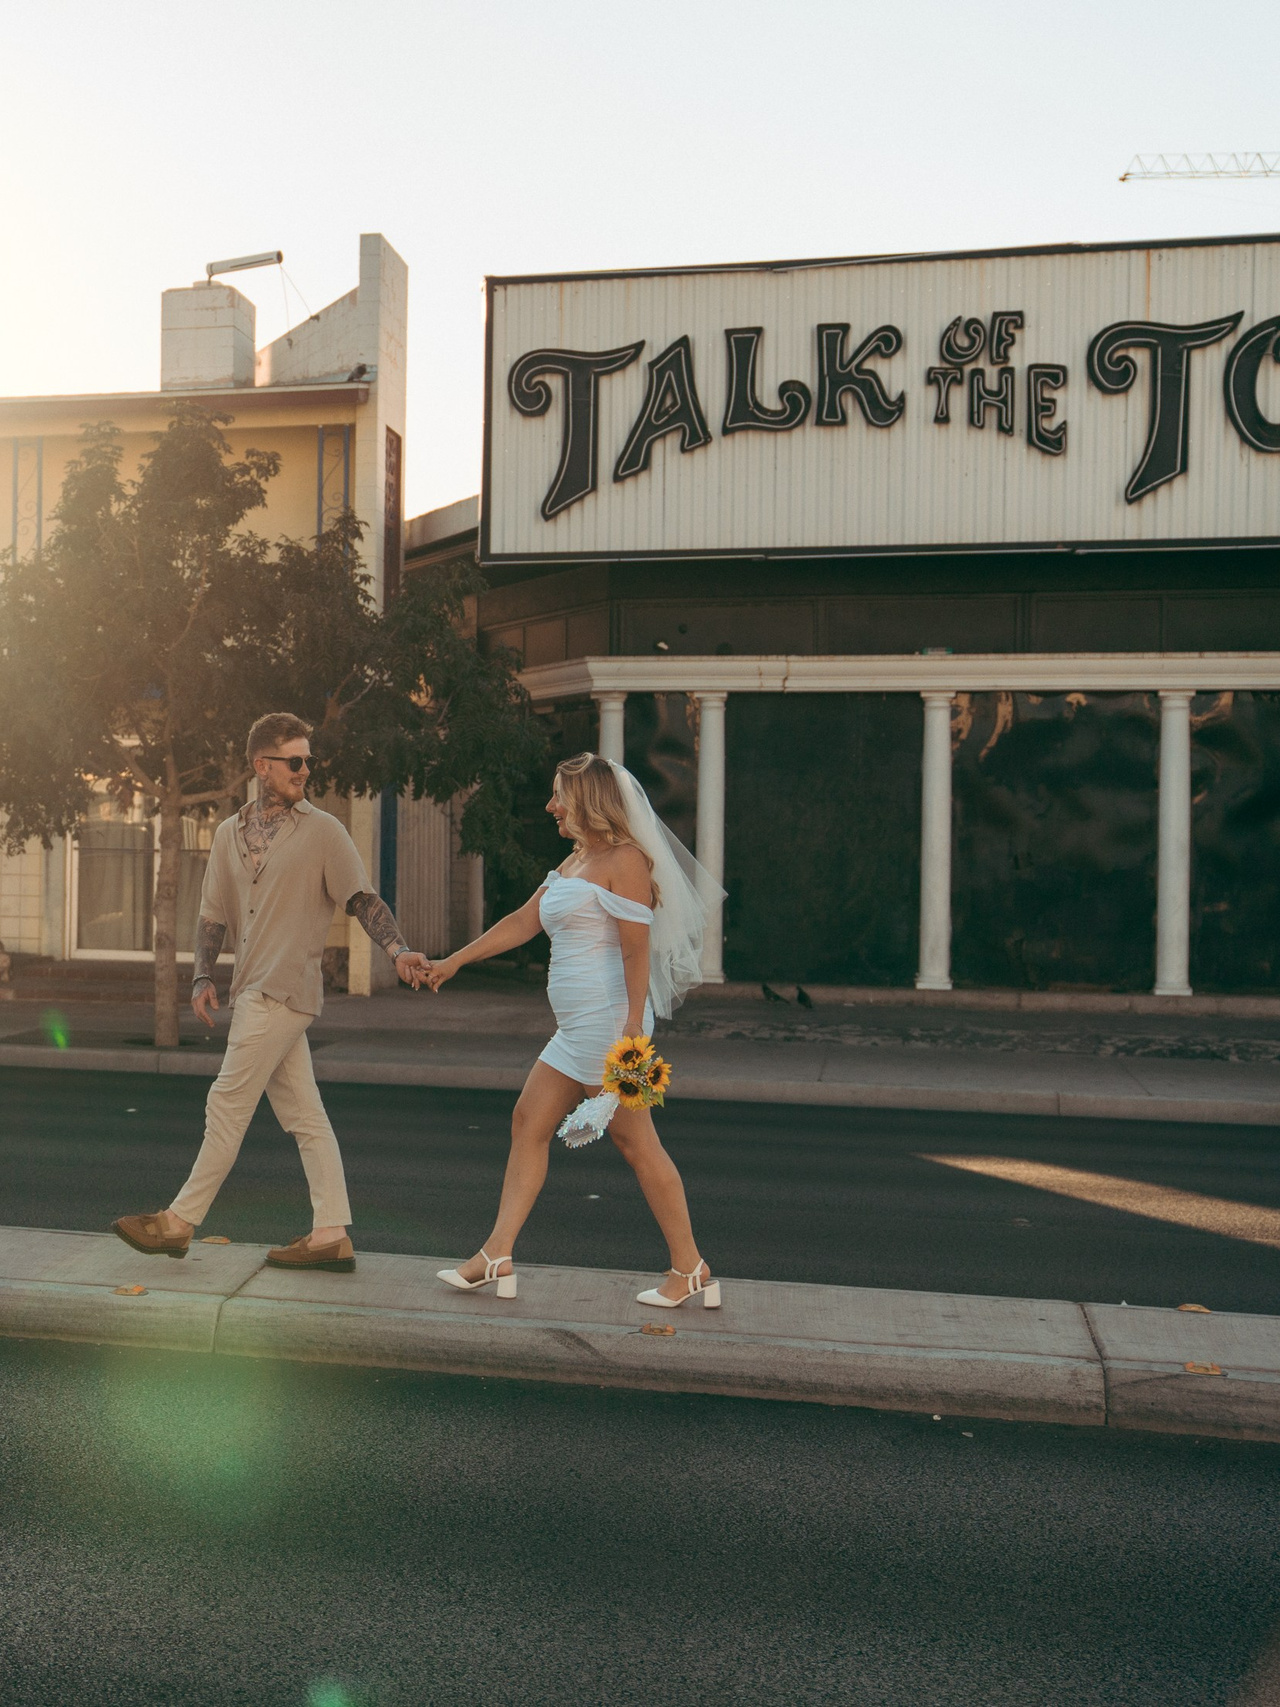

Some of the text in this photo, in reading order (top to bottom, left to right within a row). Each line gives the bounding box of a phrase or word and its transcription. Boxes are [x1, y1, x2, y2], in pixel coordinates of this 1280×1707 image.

[940, 310, 1024, 366] OF
[507, 322, 905, 522] TALK
[926, 364, 1068, 456] THE
